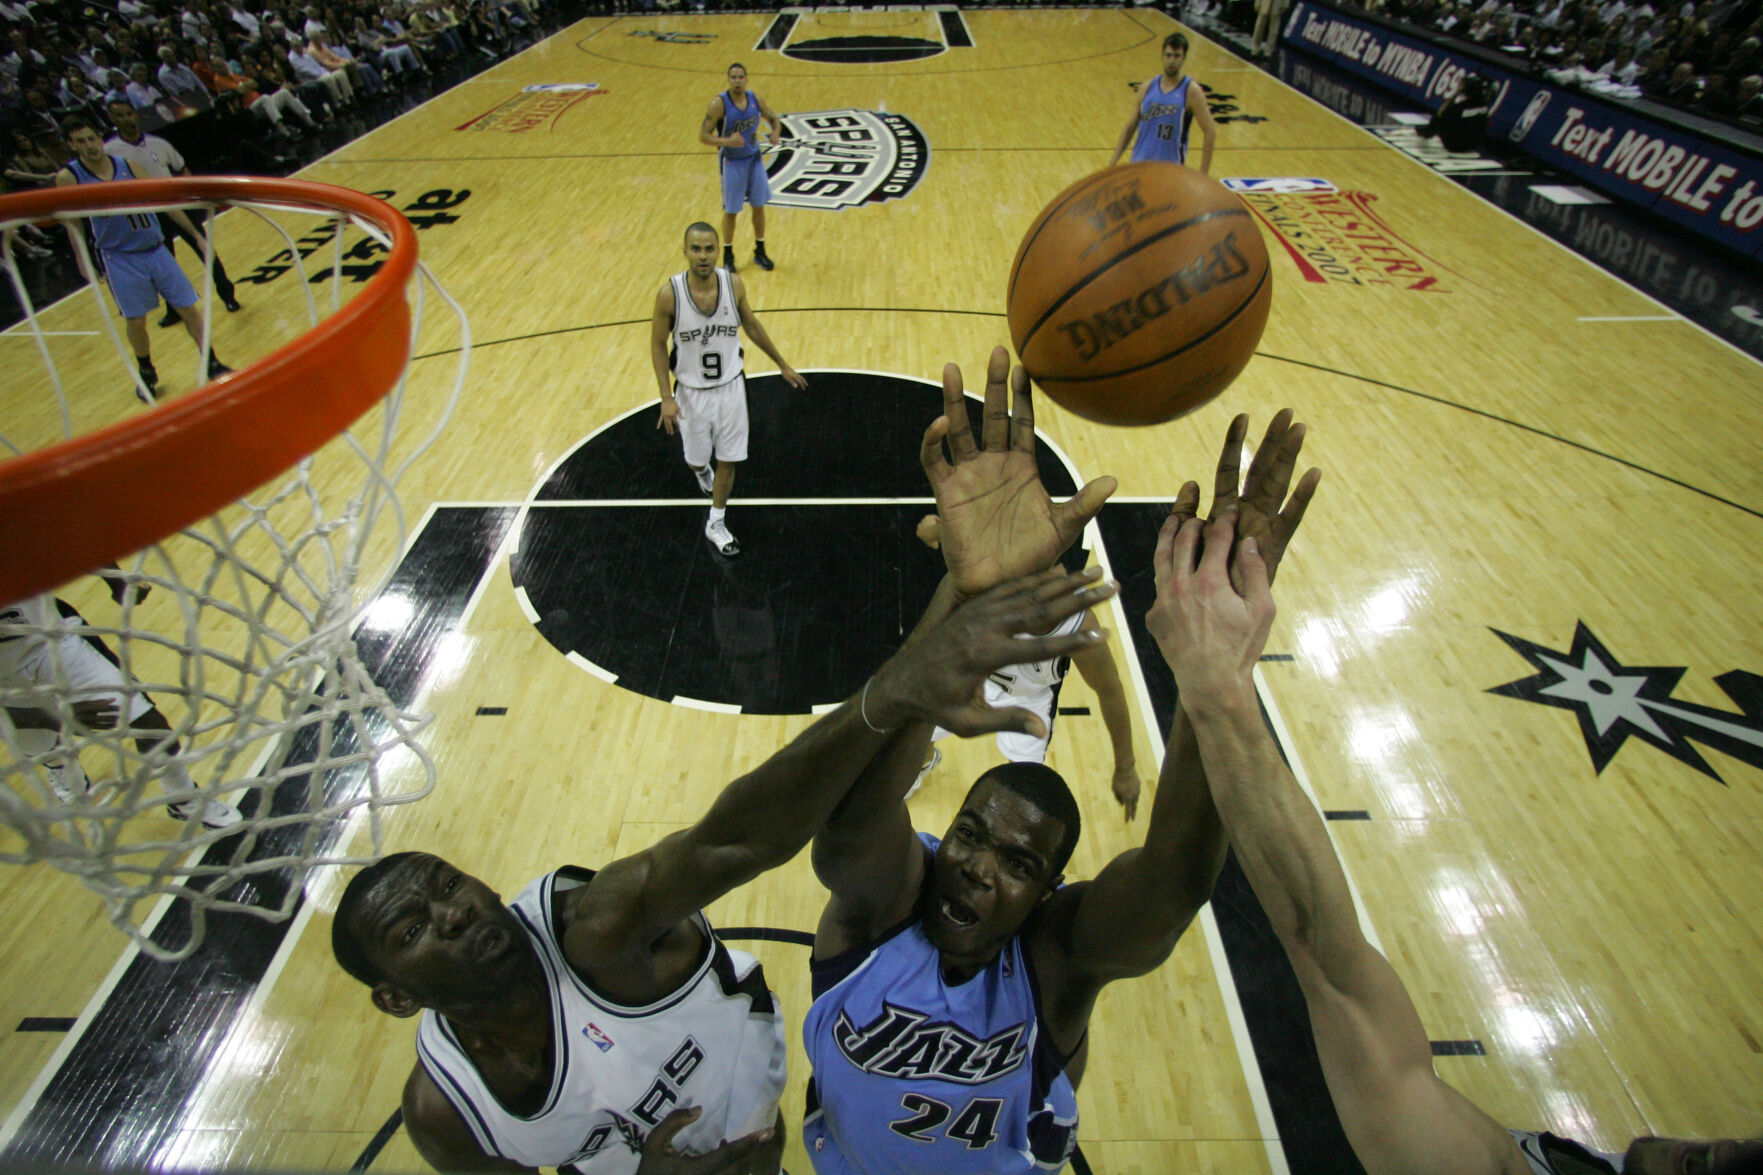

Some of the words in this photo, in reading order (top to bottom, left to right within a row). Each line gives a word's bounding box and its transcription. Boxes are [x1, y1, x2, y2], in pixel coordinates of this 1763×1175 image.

[1301, 11, 1327, 45] Text
[1320, 20, 1371, 60] MOBILE
[1362, 38, 1383, 66] to
[1377, 42, 1434, 88] MYNBA
[1425, 58, 1511, 118] (69)
[780, 116, 878, 198] SPURS
[883, 140, 918, 194] ANTONIO
[884, 117, 913, 137] SAN
[1156, 124, 1175, 142] 13
[1552, 107, 1613, 163] Text
[1603, 129, 1738, 213] MOBILE
[1720, 180, 1763, 230] to
[1247, 193, 1313, 242] FINALS
[1299, 239, 1364, 287] 2007
[1305, 194, 1453, 294] WESTERN
[680, 324, 738, 346] SPURS
[1057, 231, 1249, 363] SPALDING
[702, 352, 723, 382] 9
[832, 1000, 1029, 1085] JAZZ
[887, 1093, 1004, 1150] 24
